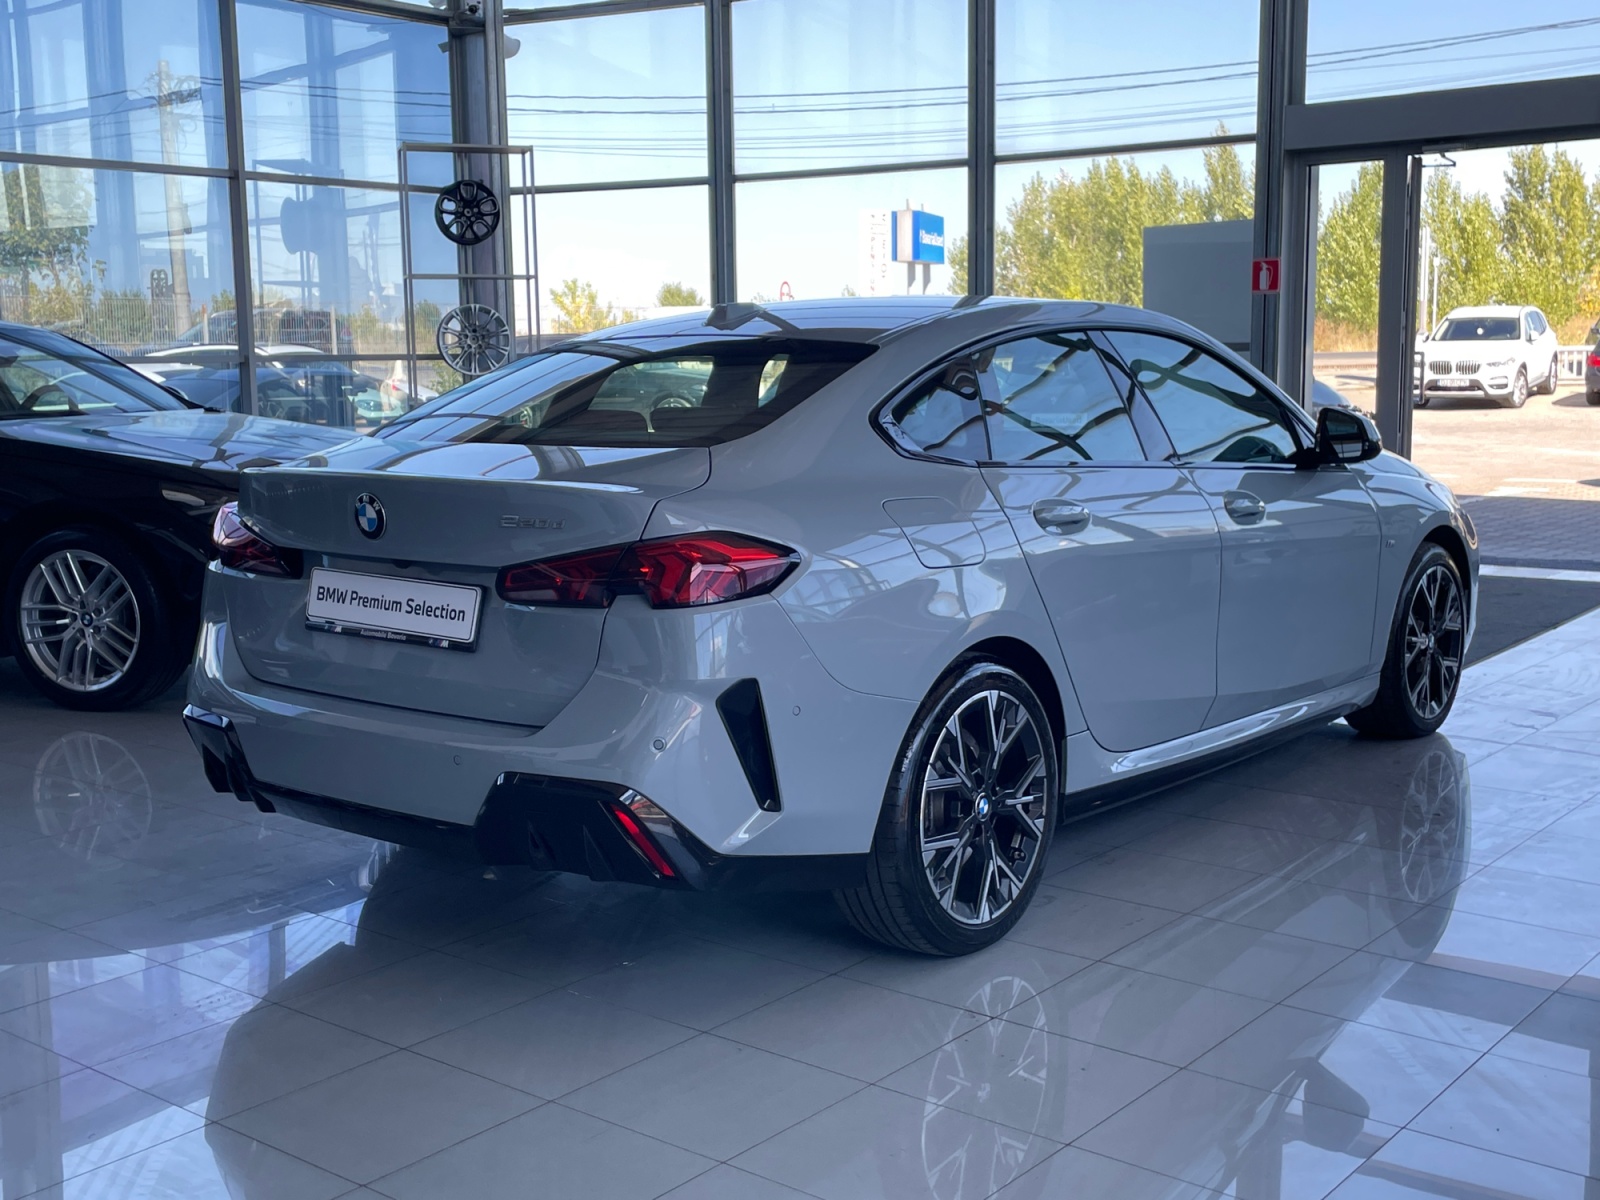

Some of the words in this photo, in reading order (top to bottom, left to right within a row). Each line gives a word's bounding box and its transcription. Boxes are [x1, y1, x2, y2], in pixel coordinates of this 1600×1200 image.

[316, 586, 348, 604] BMW
[350, 590, 402, 612] Premium
[405, 598, 465, 621] Selection
